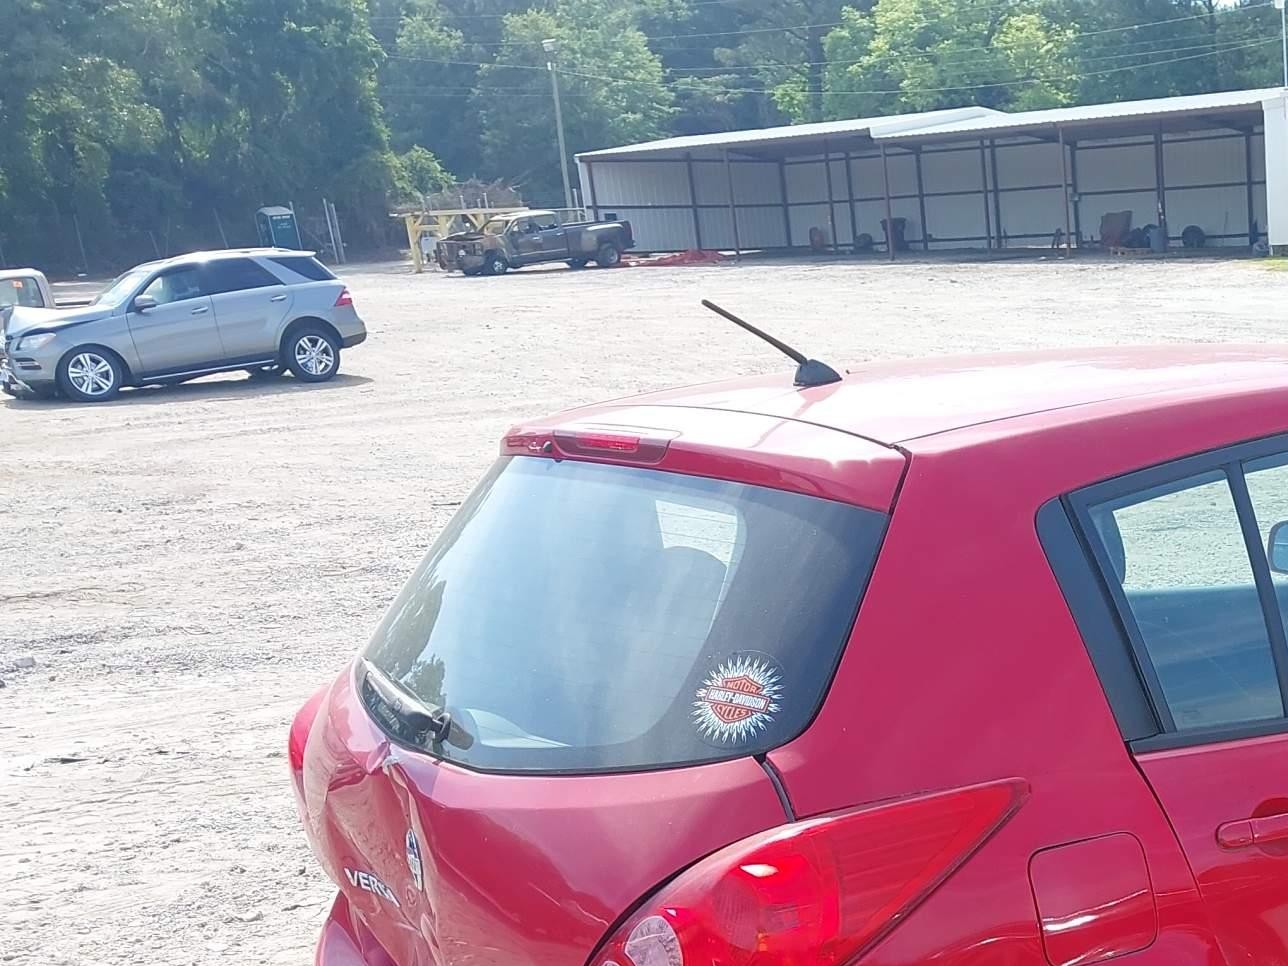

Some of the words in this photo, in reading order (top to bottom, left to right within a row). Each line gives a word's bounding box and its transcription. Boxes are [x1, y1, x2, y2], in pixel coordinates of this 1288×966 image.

[726, 680, 758, 694] MOTOR
[708, 689, 767, 710] HARLEY-DAVIDSON
[716, 704, 748, 719] CYCLES
